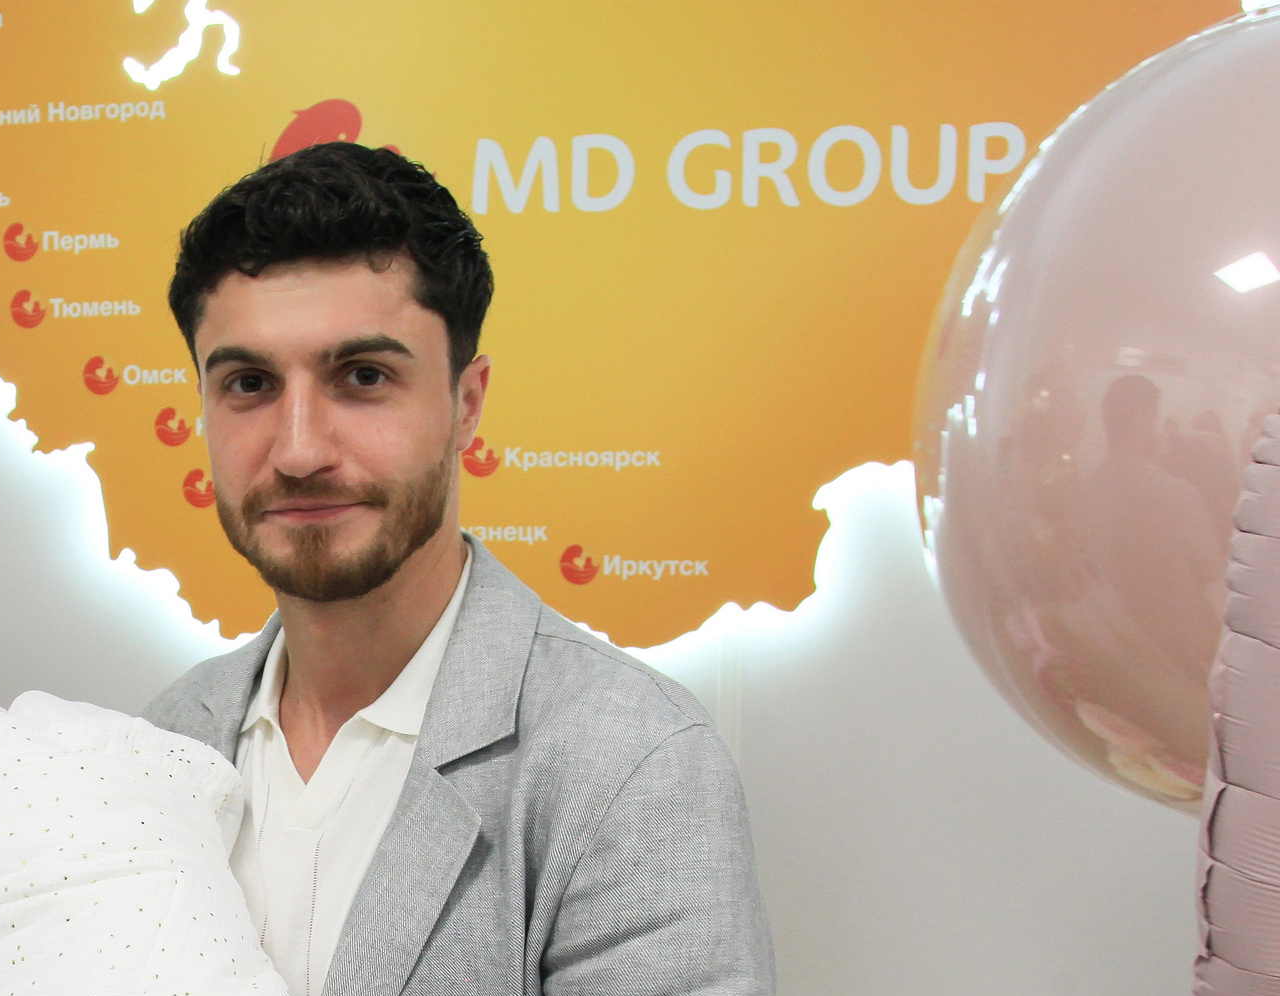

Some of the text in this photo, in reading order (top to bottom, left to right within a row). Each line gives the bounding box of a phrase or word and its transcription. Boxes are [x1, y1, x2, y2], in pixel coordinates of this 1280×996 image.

[48, 100, 166, 123] Новгород
[471, 121, 1026, 215] MD GROUP
[42, 230, 120, 254] Пермь
[49, 297, 141, 318] Тюмень
[122, 364, 188, 386] Омск
[504, 446, 661, 472] Красноярск
[603, 554, 709, 581] Иркутск
